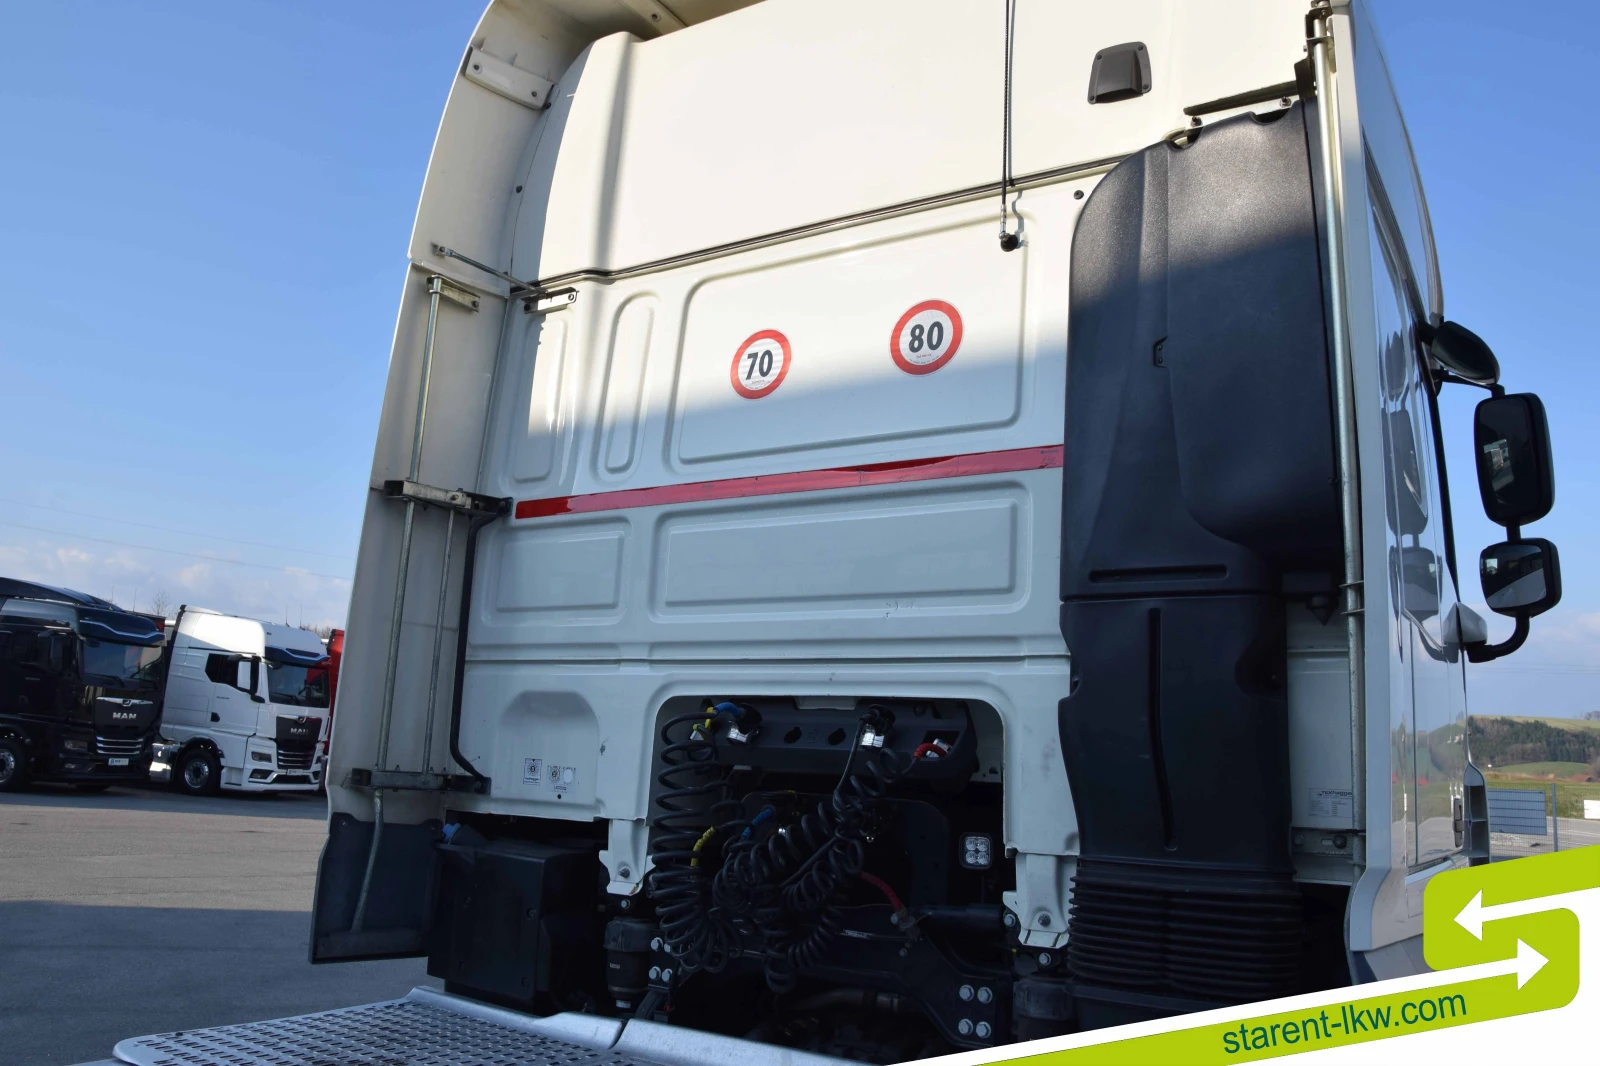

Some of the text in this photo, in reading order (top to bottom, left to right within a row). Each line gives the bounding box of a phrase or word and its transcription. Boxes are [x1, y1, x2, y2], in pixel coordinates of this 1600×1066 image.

[908, 321, 944, 353] 80
[745, 349, 774, 381] 70
[112, 711, 137, 720] MAN
[290, 727, 309, 735] MAN
